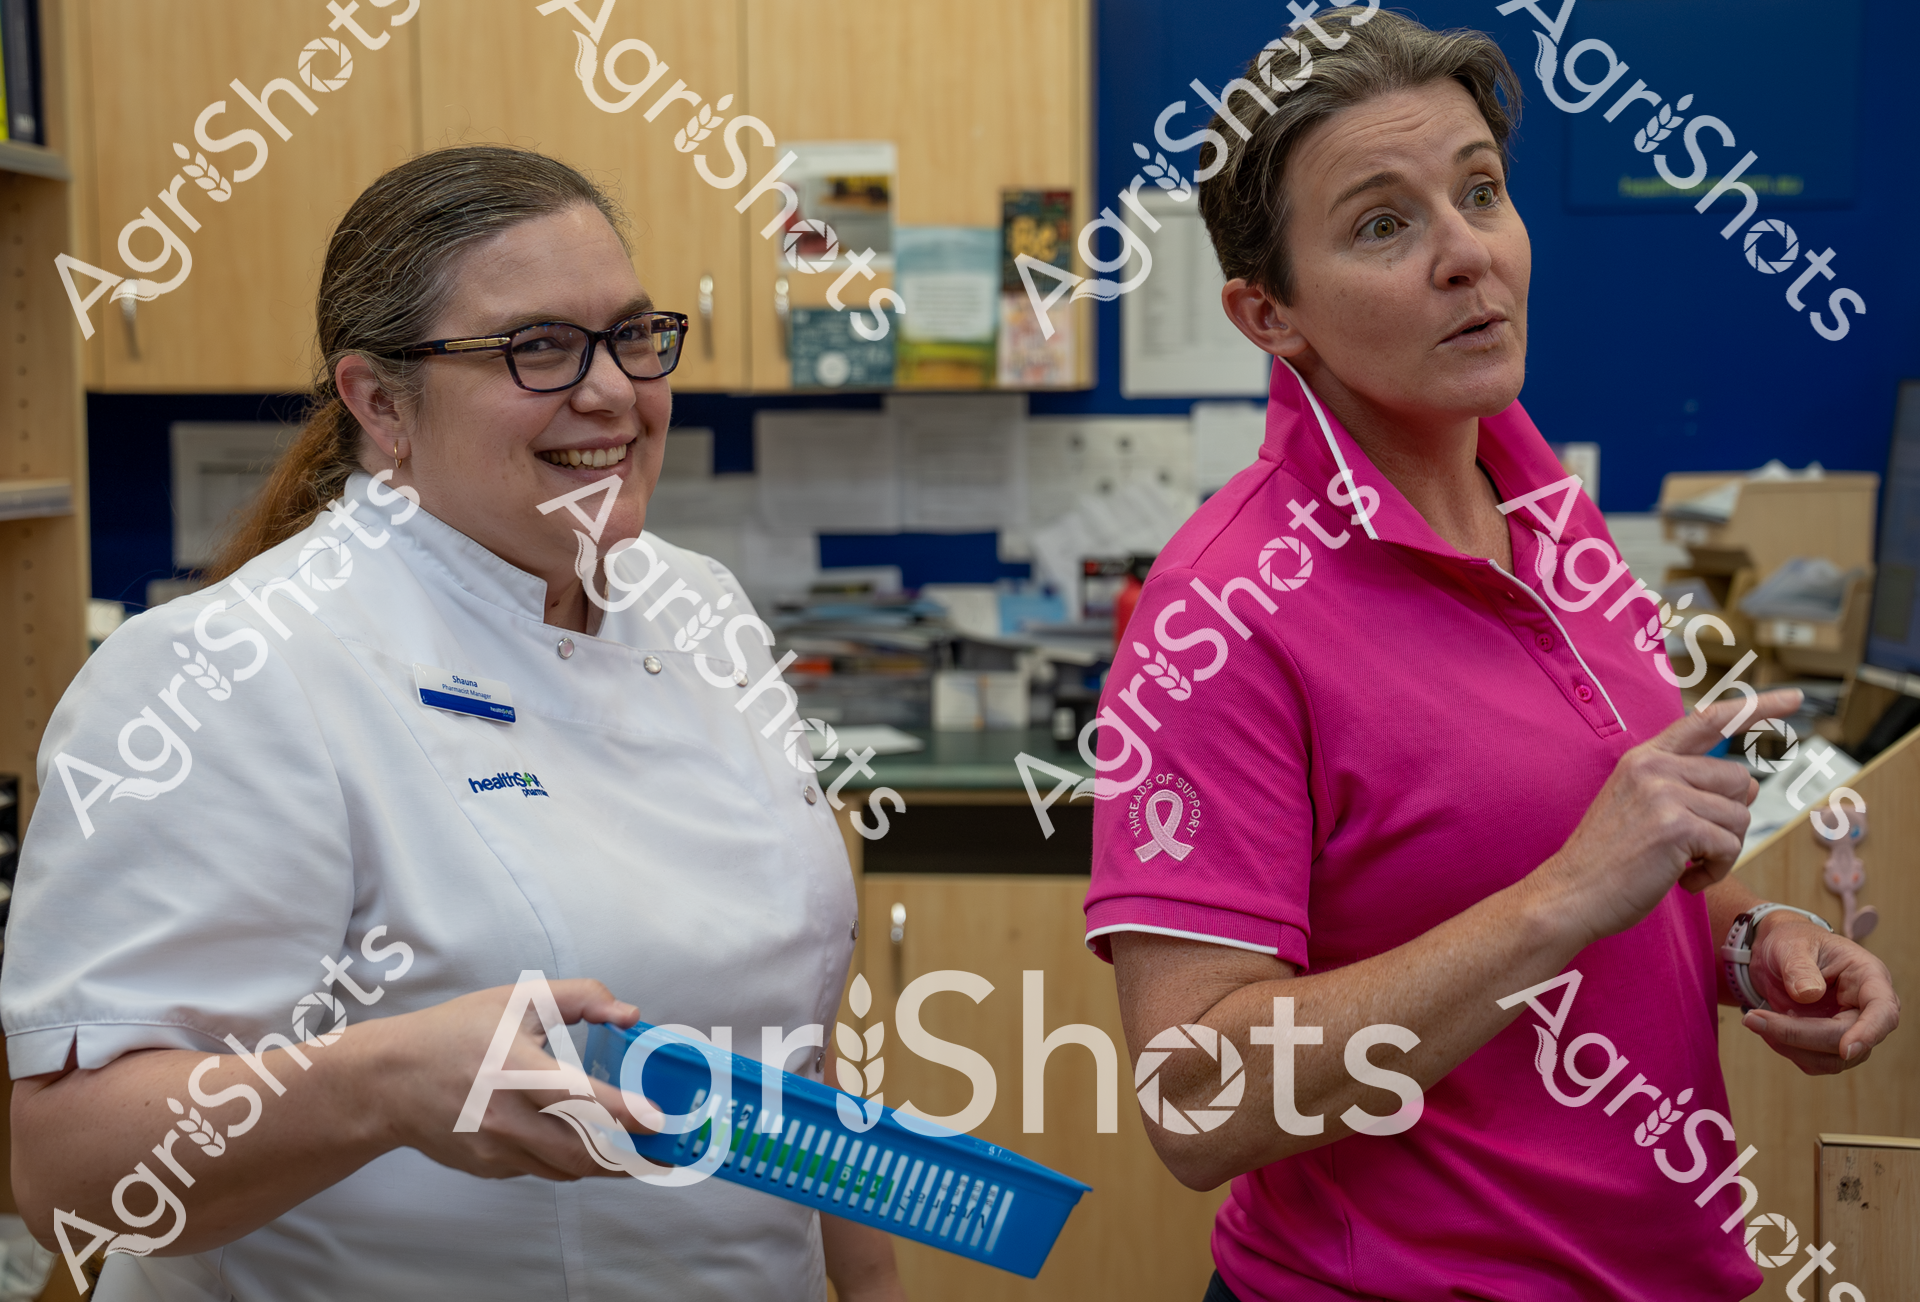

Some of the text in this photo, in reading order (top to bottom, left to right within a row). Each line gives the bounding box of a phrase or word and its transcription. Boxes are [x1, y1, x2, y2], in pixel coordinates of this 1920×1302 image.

[452, 675, 478, 688] Shauna
[441, 683, 491, 700] Pharmacist Manager
[1128, 773, 1202, 838] THREADS OF SUPPORT
